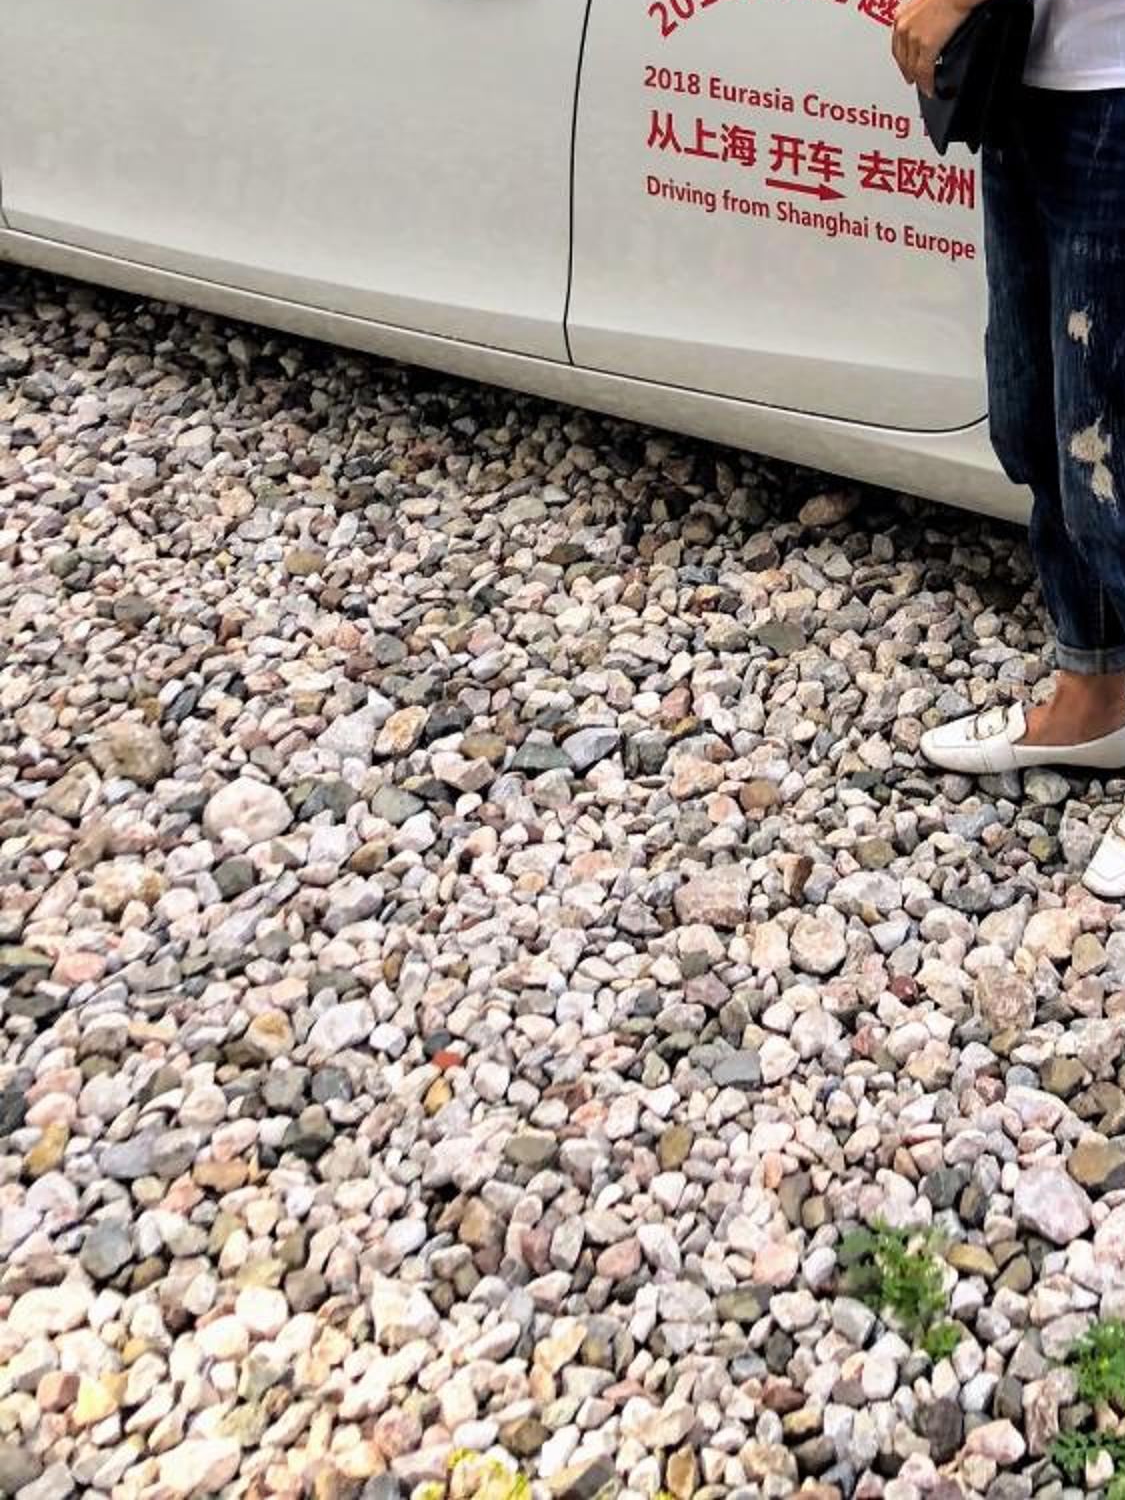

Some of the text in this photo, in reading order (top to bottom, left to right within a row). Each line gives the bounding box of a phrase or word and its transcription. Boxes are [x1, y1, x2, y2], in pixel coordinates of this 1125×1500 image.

[644, 65, 701, 95] 2018
[708, 77, 795, 112] Eurasia
[803, 94, 911, 138] Crossing
[646, 109, 976, 210] 从上海 开车 去欧洲
[646, 175, 976, 261] Driving from Shanghai to Europe
